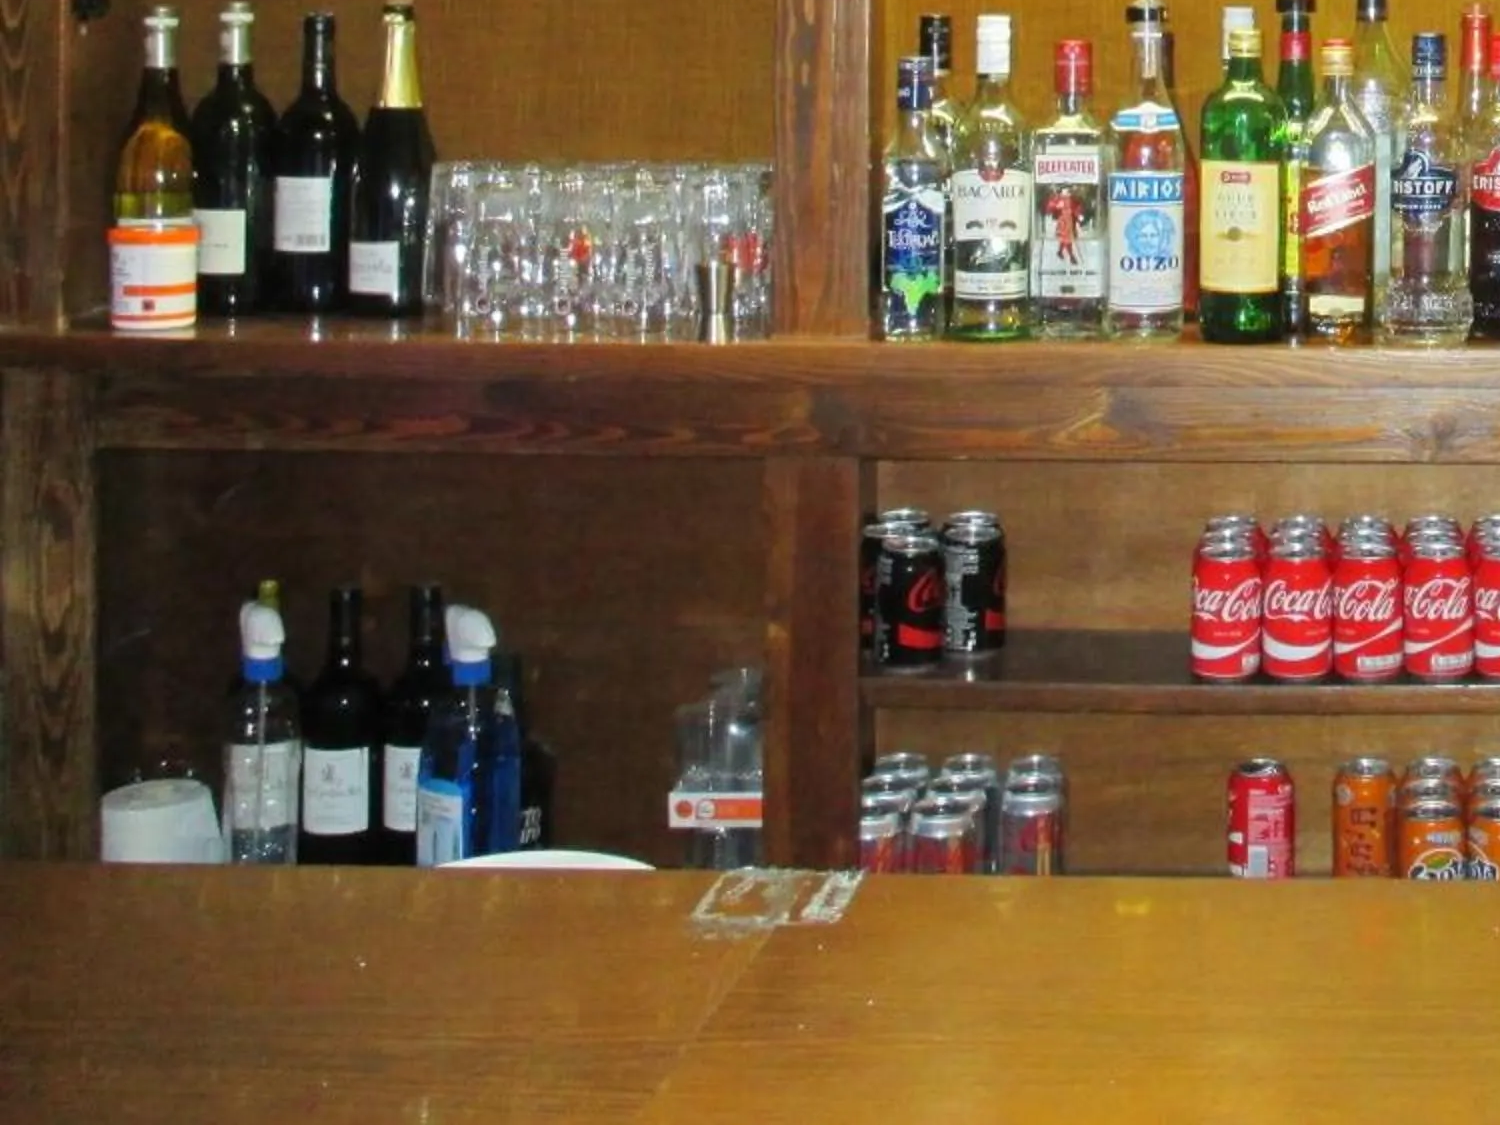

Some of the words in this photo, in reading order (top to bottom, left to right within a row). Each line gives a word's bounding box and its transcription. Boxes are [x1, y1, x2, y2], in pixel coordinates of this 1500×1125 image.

[1038, 160, 1095, 175] BEEFEATER
[958, 184, 1025, 198] BACARDI
[1120, 256, 1179, 272] OUZO
